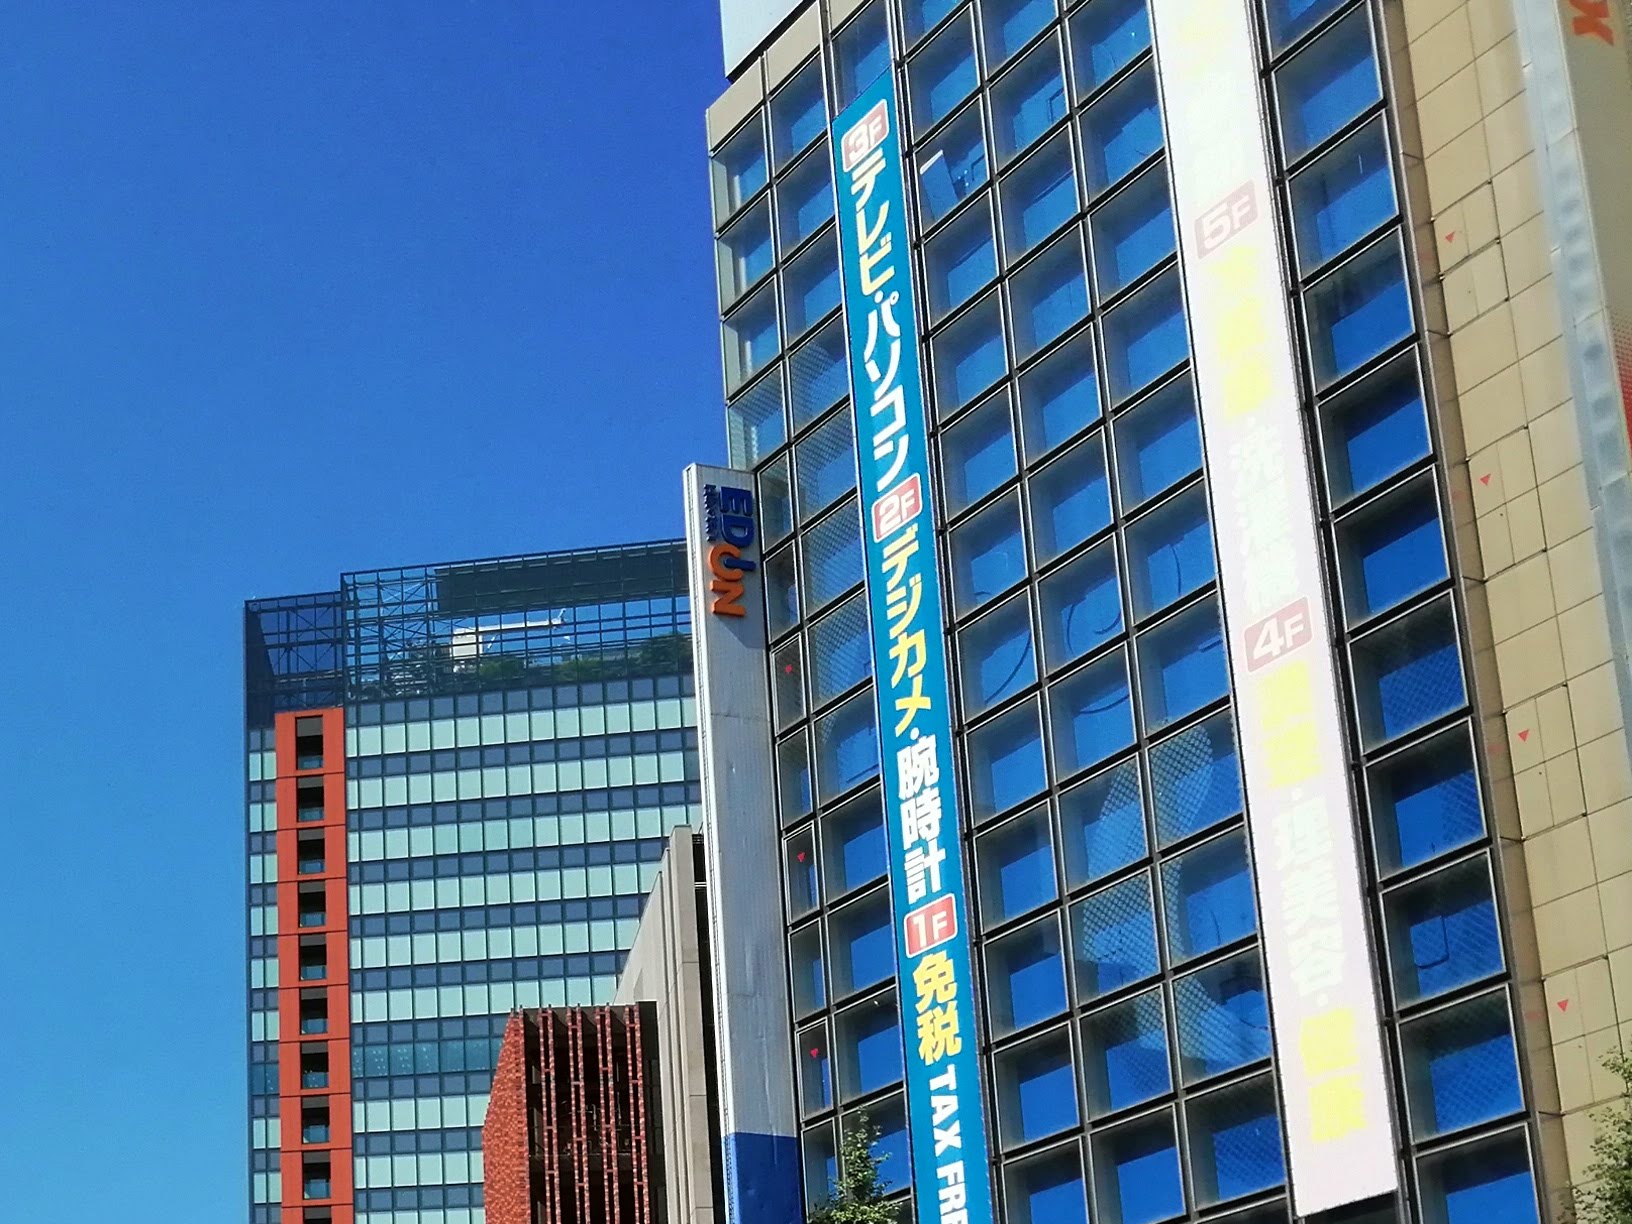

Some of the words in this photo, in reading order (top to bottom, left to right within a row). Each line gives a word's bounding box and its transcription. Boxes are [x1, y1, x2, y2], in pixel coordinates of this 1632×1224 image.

[845, 114, 883, 163] 3F
[851, 148, 909, 492] テレビ・パソコン
[1200, 192, 1254, 251] 5F
[1251, 615, 1307, 666] 4F
[708, 485, 757, 618] EDION
[878, 487, 919, 532] 2F
[881, 527, 946, 904] デジカメ・腕時計
[911, 908, 949, 948] 1F
[913, 949, 963, 1066] 免税
[929, 1063, 963, 1157] TAX
